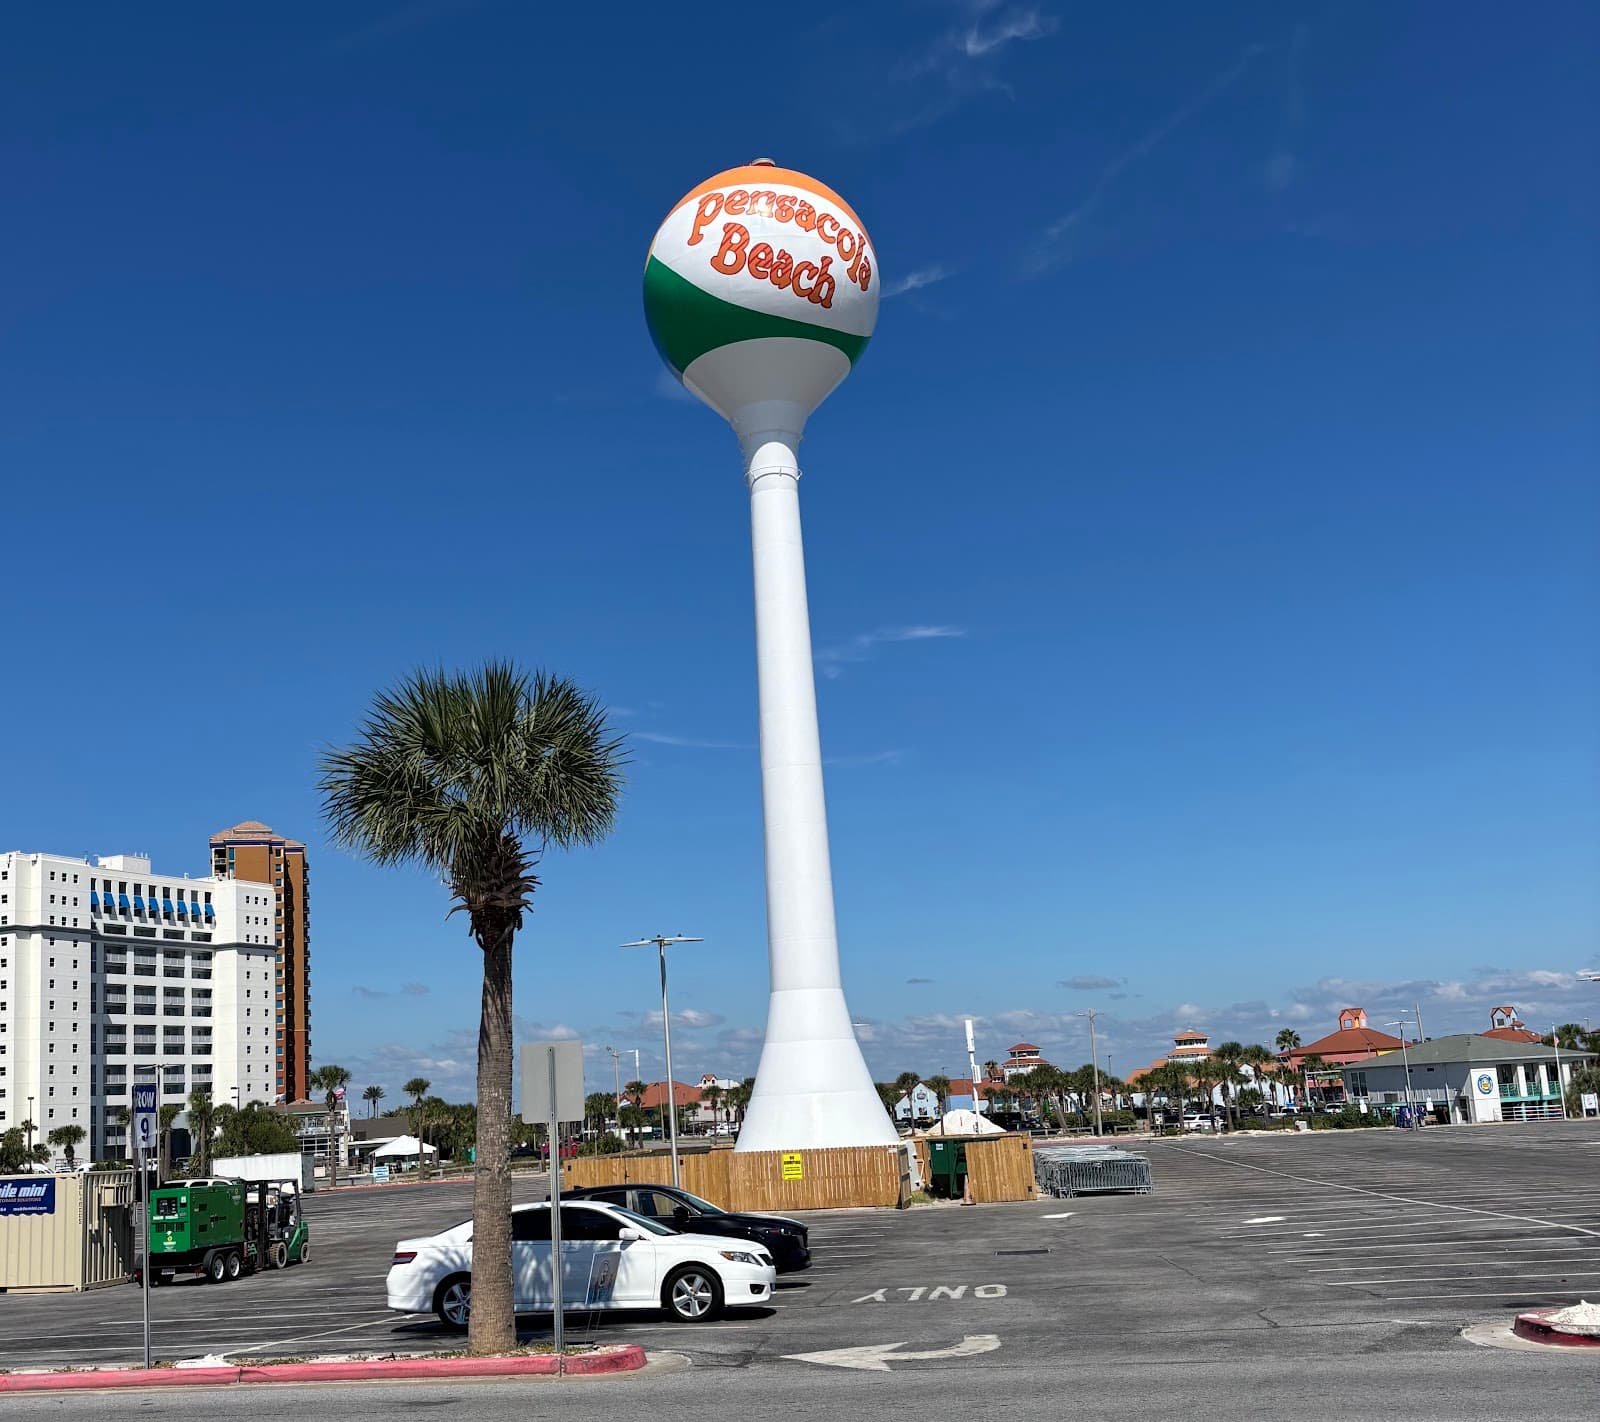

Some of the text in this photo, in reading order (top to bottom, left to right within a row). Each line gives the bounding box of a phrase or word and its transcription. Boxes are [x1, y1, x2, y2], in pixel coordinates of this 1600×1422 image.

[710, 222, 836, 309] Beach
[136, 1091, 155, 1108] ROW
[140, 1117, 149, 1142] 9
[18, 1184, 48, 1197] mini
[851, 1284, 1008, 1303] ONLY
